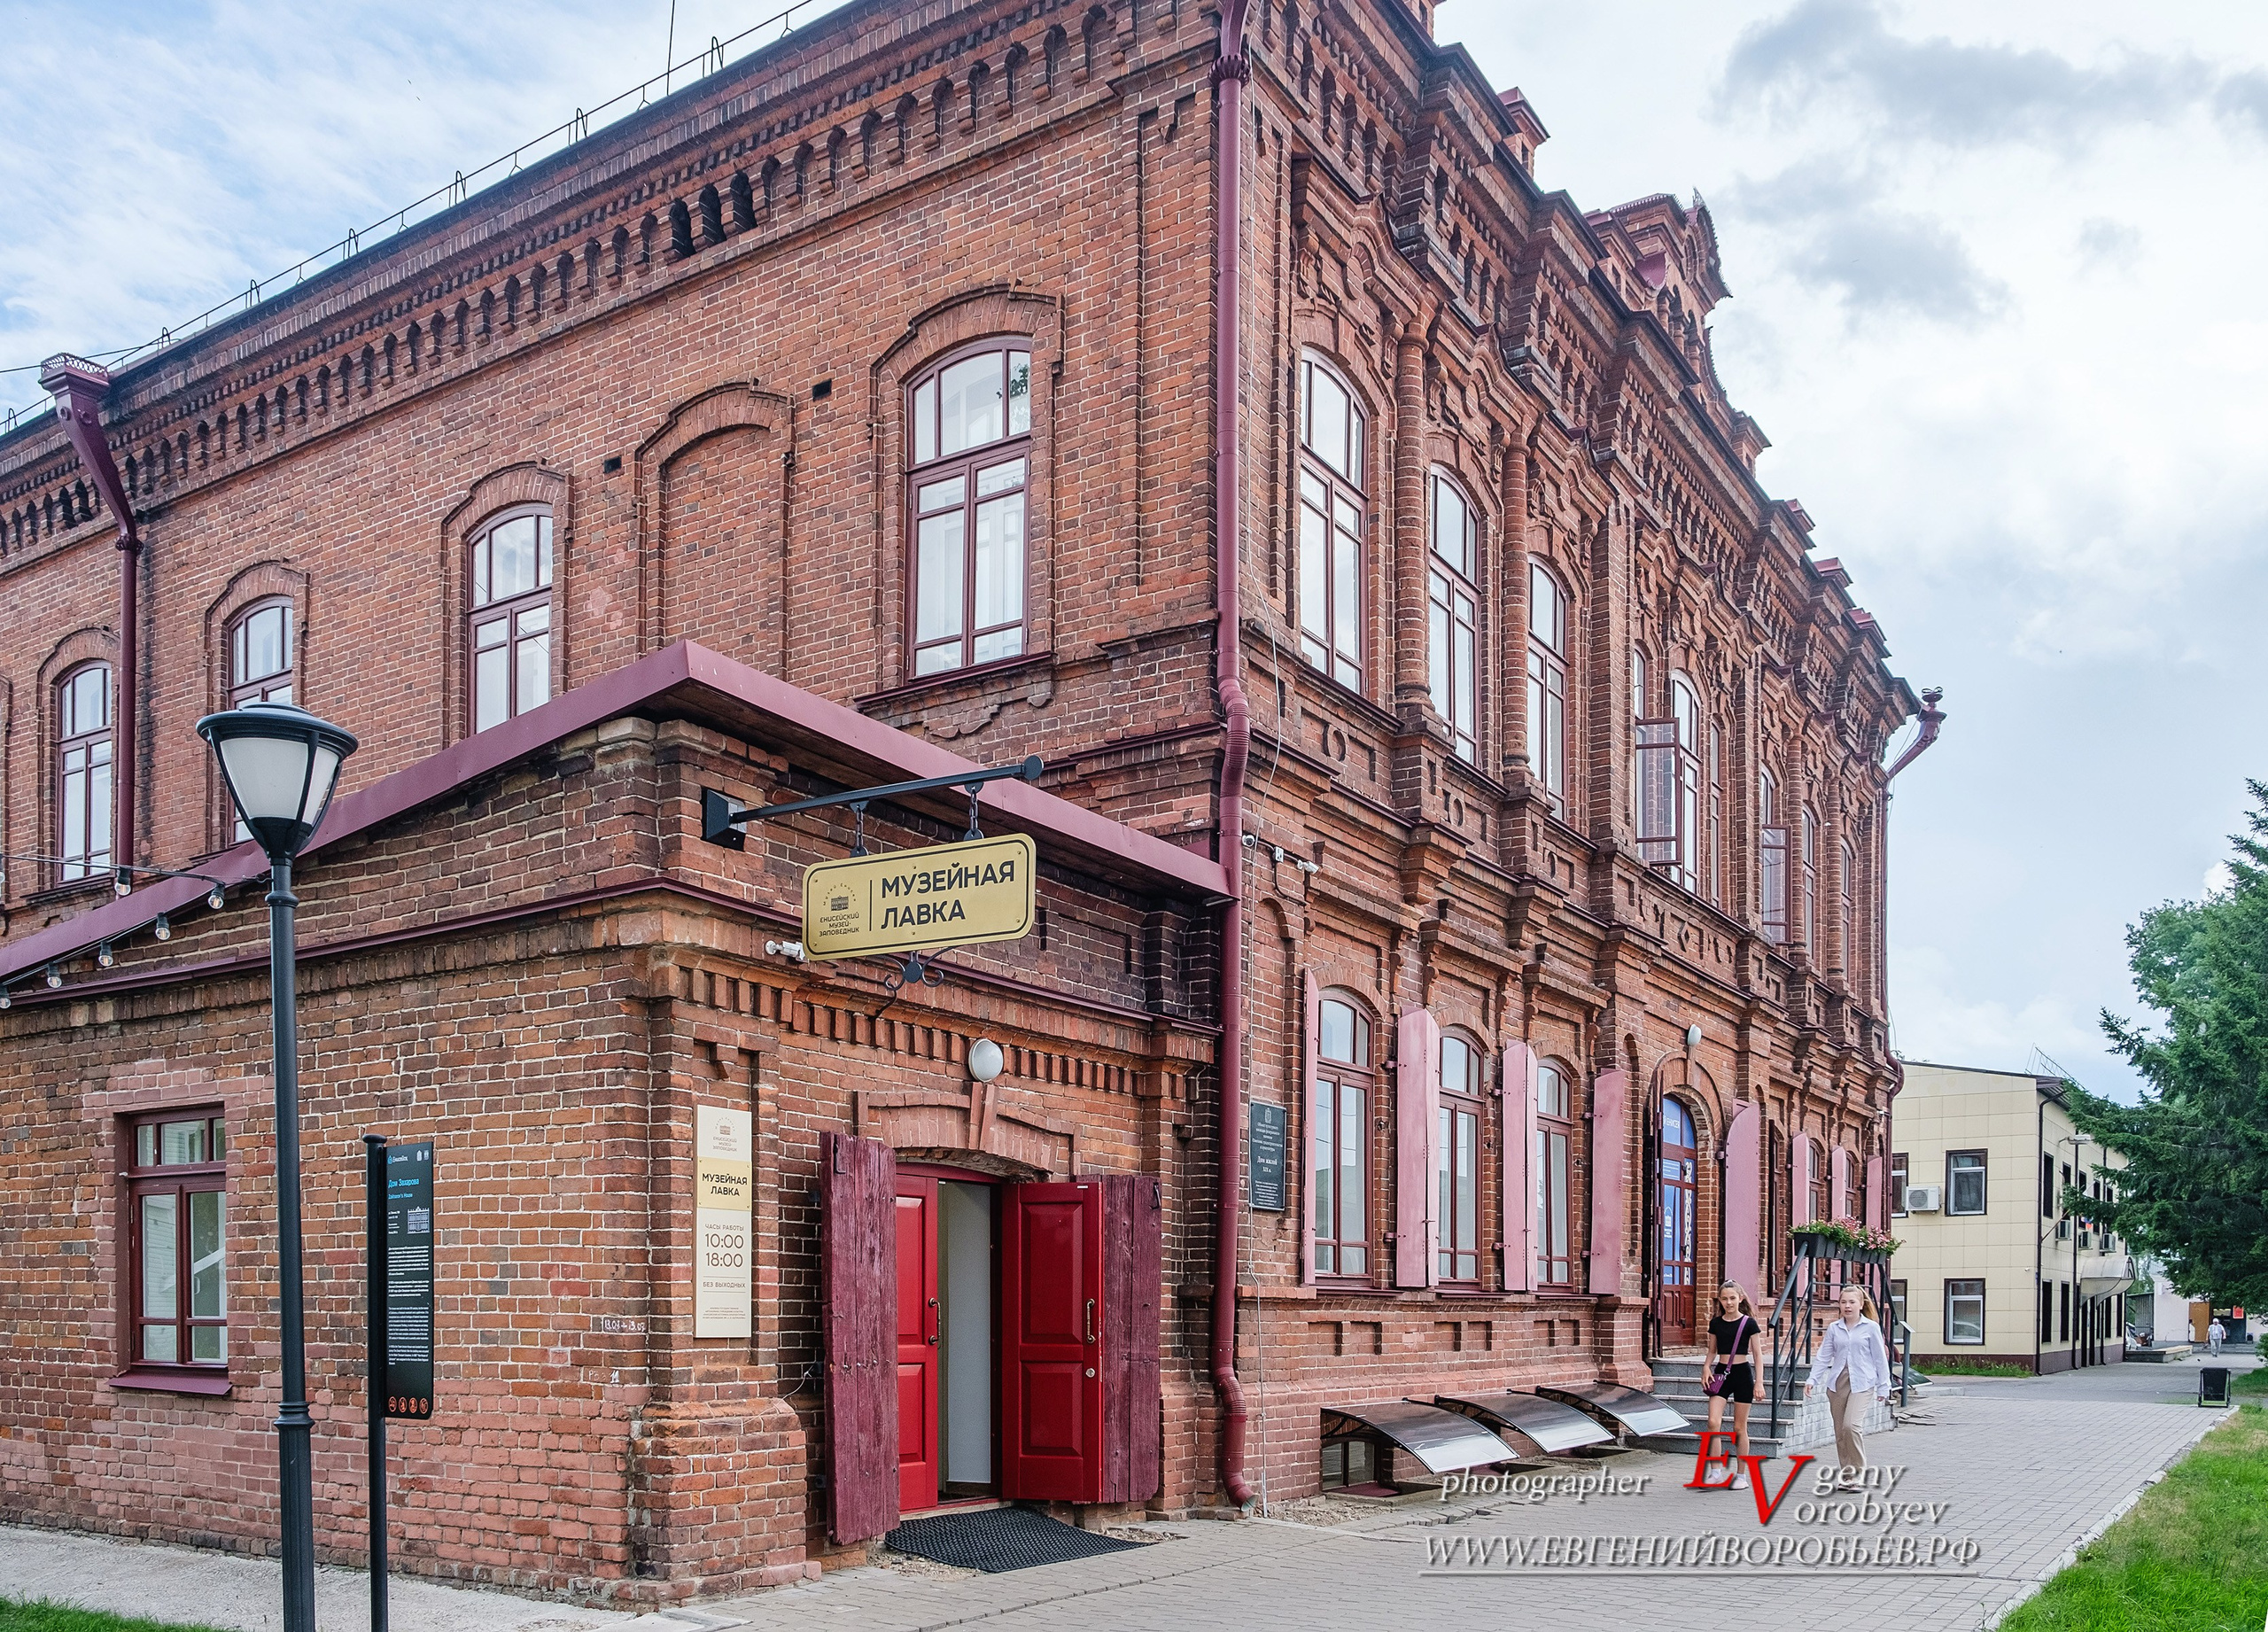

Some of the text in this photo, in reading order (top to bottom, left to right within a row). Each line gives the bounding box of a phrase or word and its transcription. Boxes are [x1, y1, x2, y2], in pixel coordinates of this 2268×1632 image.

[882, 859, 1014, 899] МУЗЕЙНАЯ
[819, 912, 859, 922] ЕНИСЕЙСКИЙ
[881, 899, 966, 929] ЛАВКА
[819, 927, 859, 937] ЗАПОВЕДНИК
[702, 1172, 748, 1185] МУЗЕЙНАЯ
[711, 1185, 741, 1196] ЛАВКА
[704, 1233, 744, 1249] 10:00
[705, 1252, 743, 1268] 18:00
